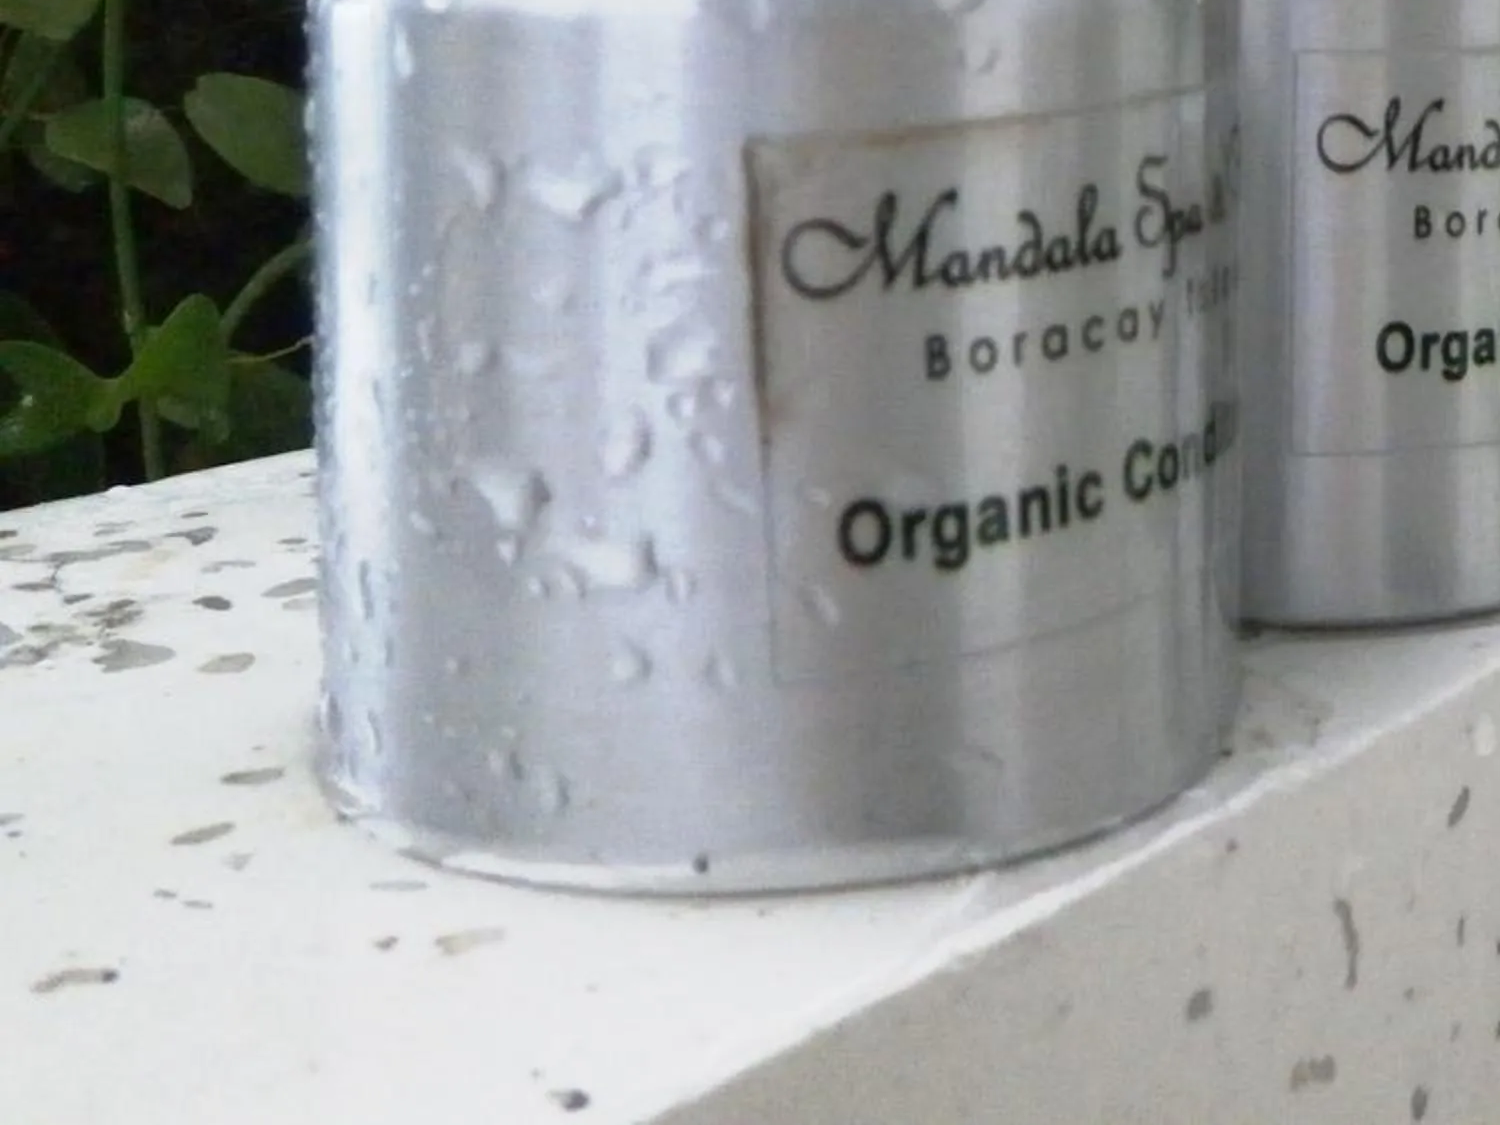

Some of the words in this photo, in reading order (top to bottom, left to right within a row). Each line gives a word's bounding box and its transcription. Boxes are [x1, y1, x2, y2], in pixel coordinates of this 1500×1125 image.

[782, 186, 1122, 300] Mandala
[924, 297, 1165, 381] Boracay
[838, 463, 1105, 572] Organic
